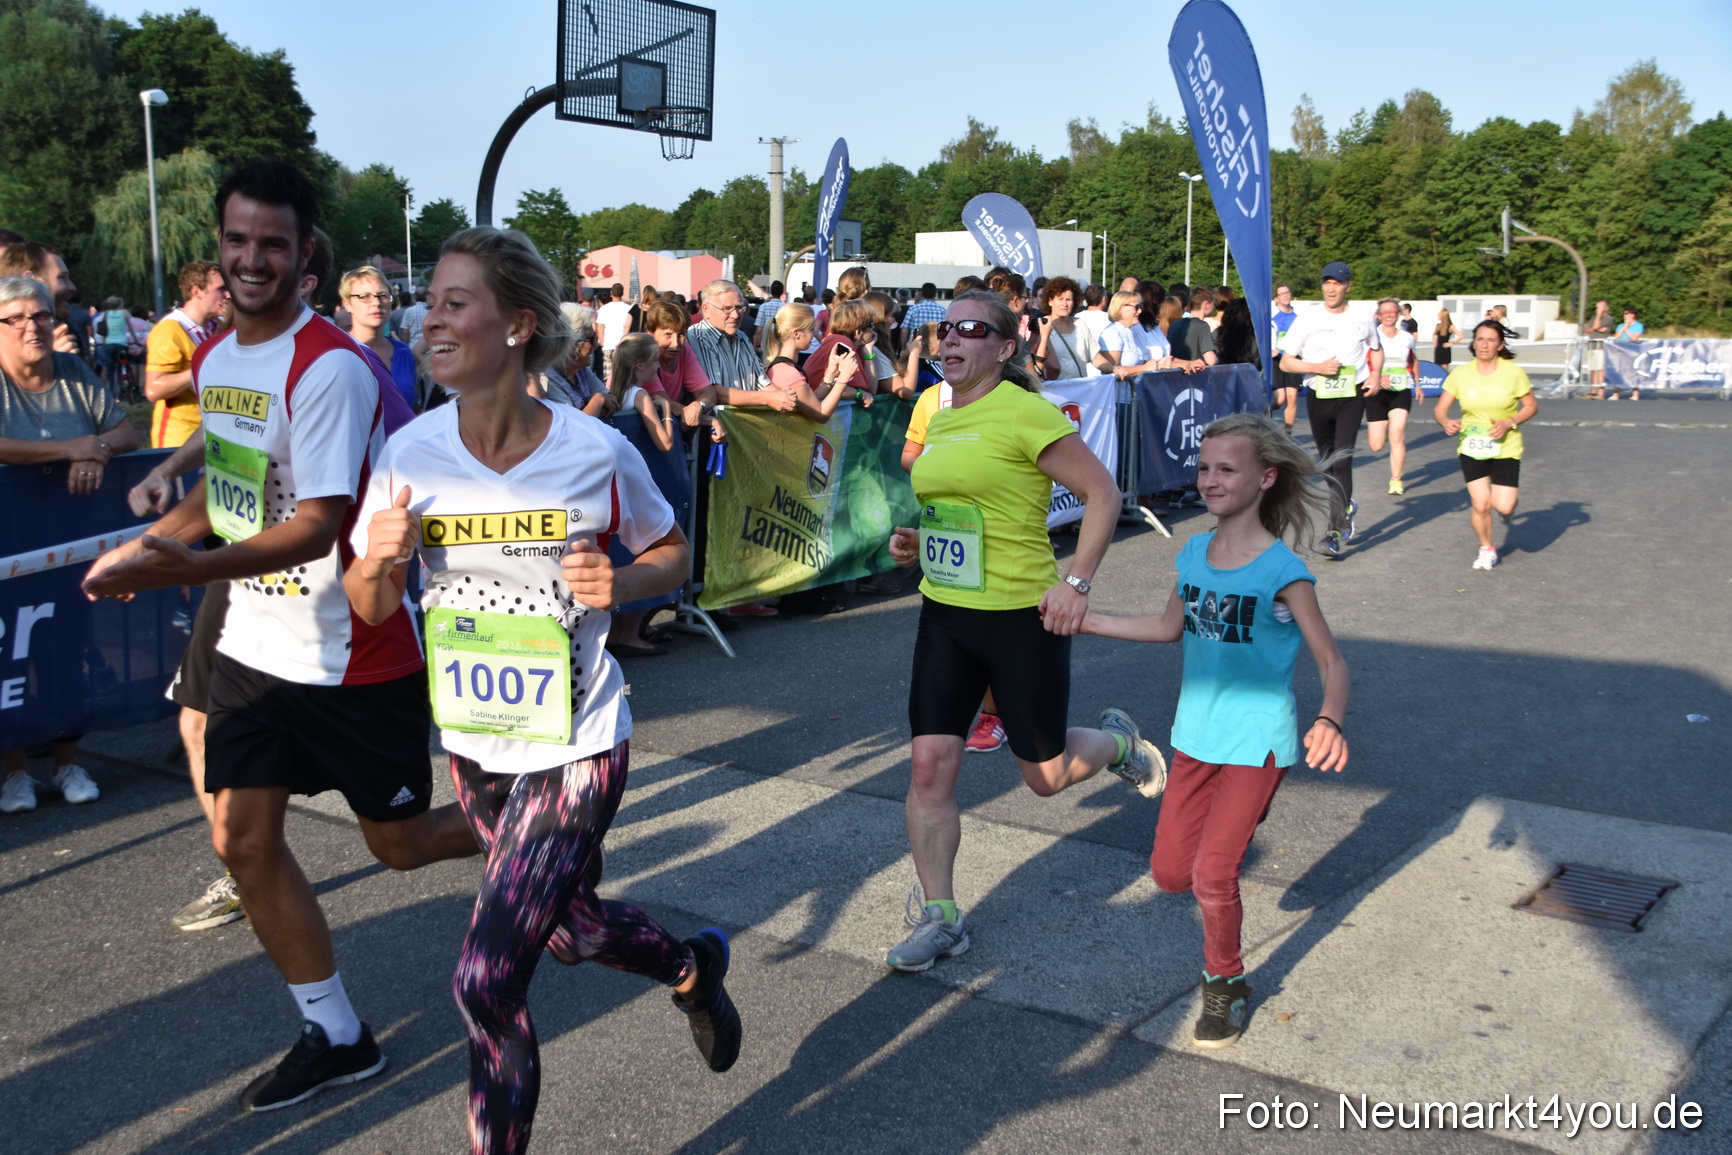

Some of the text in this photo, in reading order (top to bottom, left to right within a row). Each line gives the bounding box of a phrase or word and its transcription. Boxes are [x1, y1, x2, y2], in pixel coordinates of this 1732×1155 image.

[1650, 360, 1728, 374] Fischer
[1325, 378, 1347, 389] 527
[204, 389, 264, 416] ONLINE
[234, 417, 266, 437] Germany
[1180, 418, 1204, 450] Fis
[1469, 438, 1492, 450] 634
[1183, 454, 1200, 468] AU
[211, 475, 257, 524] 1028
[427, 514, 555, 543] ONLINE
[502, 545, 566, 558] Germany
[926, 535, 965, 567] 679
[447, 629, 494, 643] firmenlauf
[445, 660, 555, 706] 1007
[470, 709, 530, 723] Sabine Klinger
